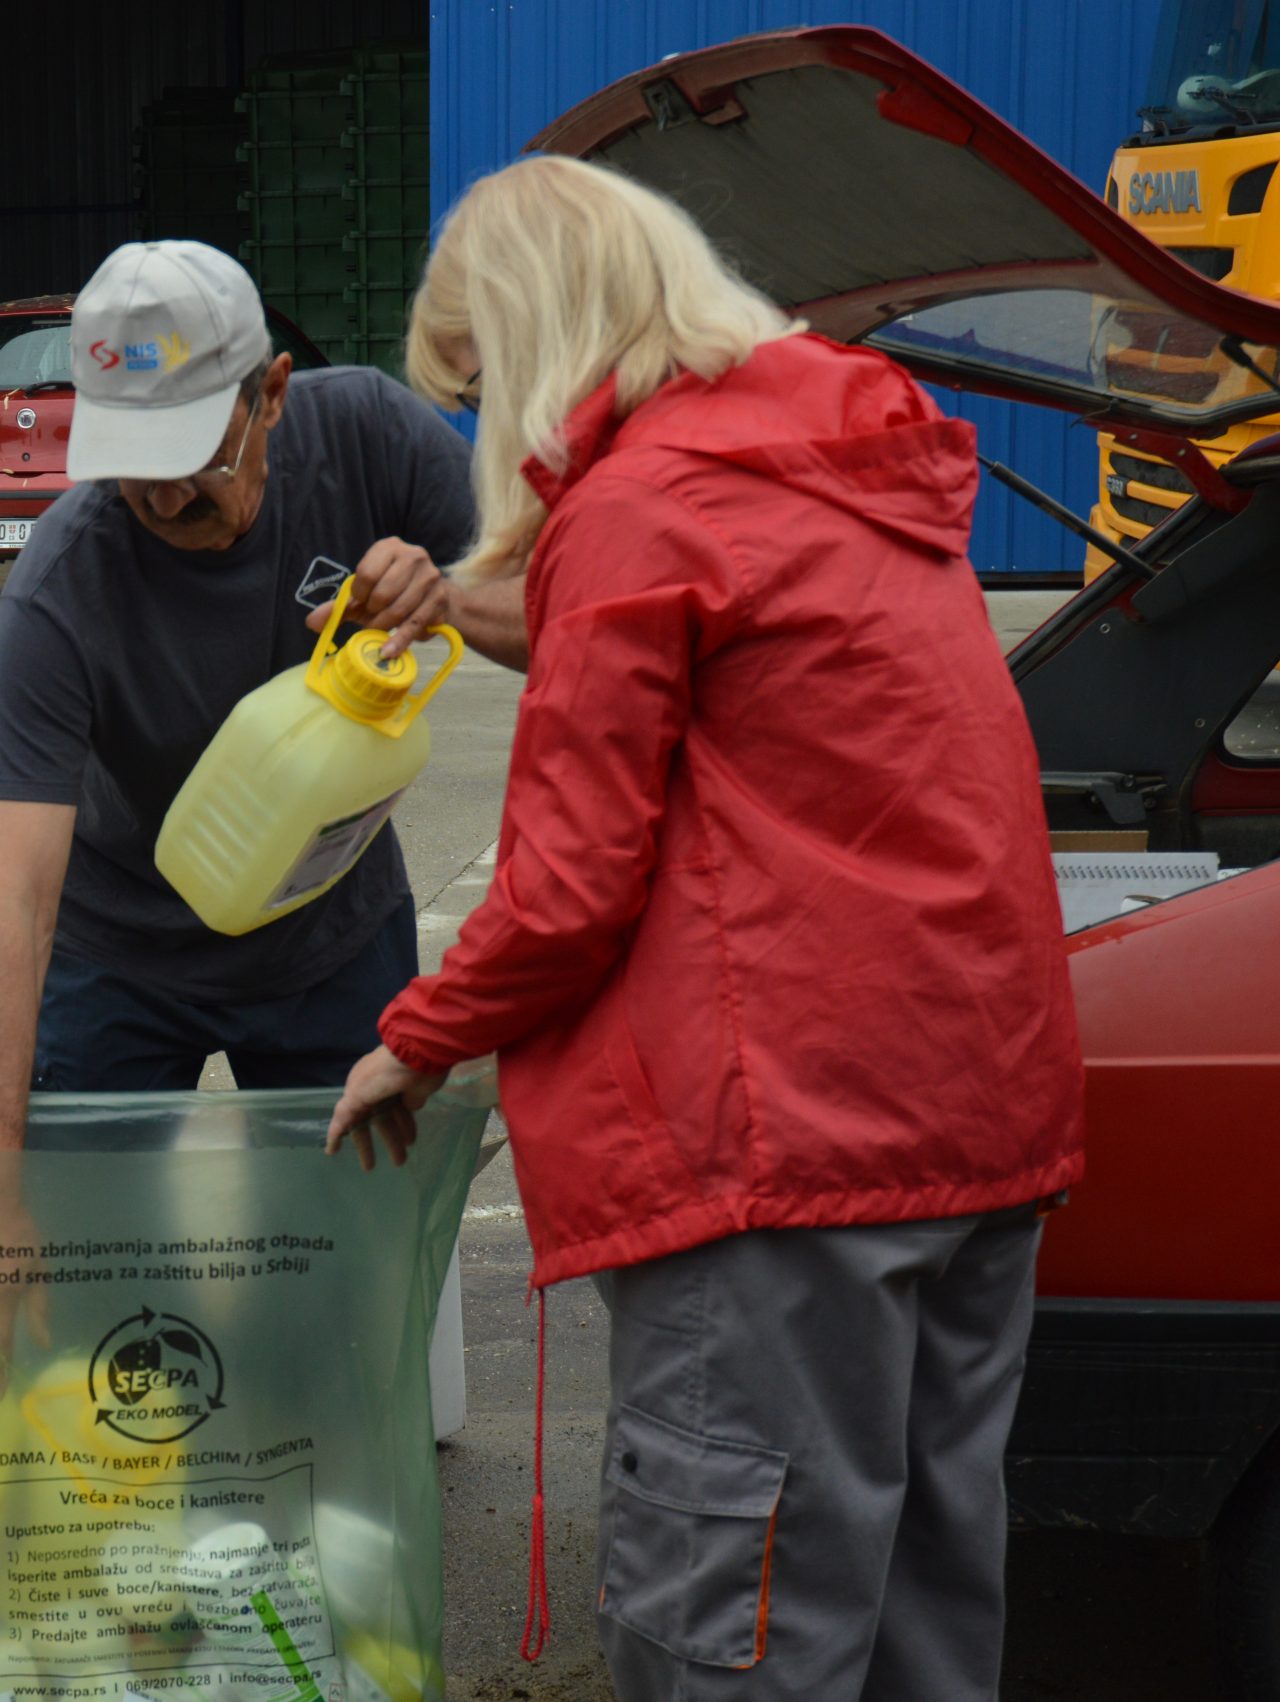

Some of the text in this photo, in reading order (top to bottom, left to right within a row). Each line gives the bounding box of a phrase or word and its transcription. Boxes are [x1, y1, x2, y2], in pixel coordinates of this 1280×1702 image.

[1129, 169, 1201, 214] SCANIA
[124, 343, 158, 358] NIS
[40, 1239, 153, 1260] zbrinjavanja
[158, 1236, 266, 1255] ambalažnog
[270, 1234, 335, 1252] otpada
[25, 1267, 112, 1284] sredstava
[120, 1266, 138, 1279] za
[143, 1264, 203, 1281] zaštitu
[209, 1262, 246, 1281] bilja
[251, 1264, 262, 1276] u
[266, 1256, 310, 1275] Srbiji
[115, 1368, 199, 1393] SECPA
[116, 1404, 203, 1420] EKO MODEL
[113, 1456, 160, 1471] BAYER
[177, 1451, 240, 1467] BELCHIM
[256, 1437, 314, 1465] SYNGENTA
[59, 1489, 107, 1505] Vreća
[113, 1493, 130, 1505] za
[135, 1494, 175, 1510] boce
[190, 1490, 265, 1509] kanistere
[5, 1519, 155, 1540] Uputstvo za upotrebu:
[27, 1545, 106, 1563] Neposredno
[110, 1544, 128, 1558] po
[209, 1541, 269, 1563] najmanje
[273, 1540, 289, 1552] tri
[8, 1569, 57, 1584] isperite
[63, 1563, 128, 1580] ambalažu
[135, 1562, 152, 1574] od
[160, 1564, 222, 1580] sredstava
[229, 1569, 243, 1579] za
[28, 1587, 60, 1603] Čiste
[78, 1586, 109, 1598] suve
[9, 1608, 69, 1622] smestite
[79, 1609, 87, 1619] u
[96, 1606, 123, 1618] ovu
[132, 1600, 173, 1614] vreću
[31, 1628, 87, 1643] Predajte
[97, 1621, 161, 1638] ambalažu
[13, 1685, 107, 1699] www.secpa.rs
